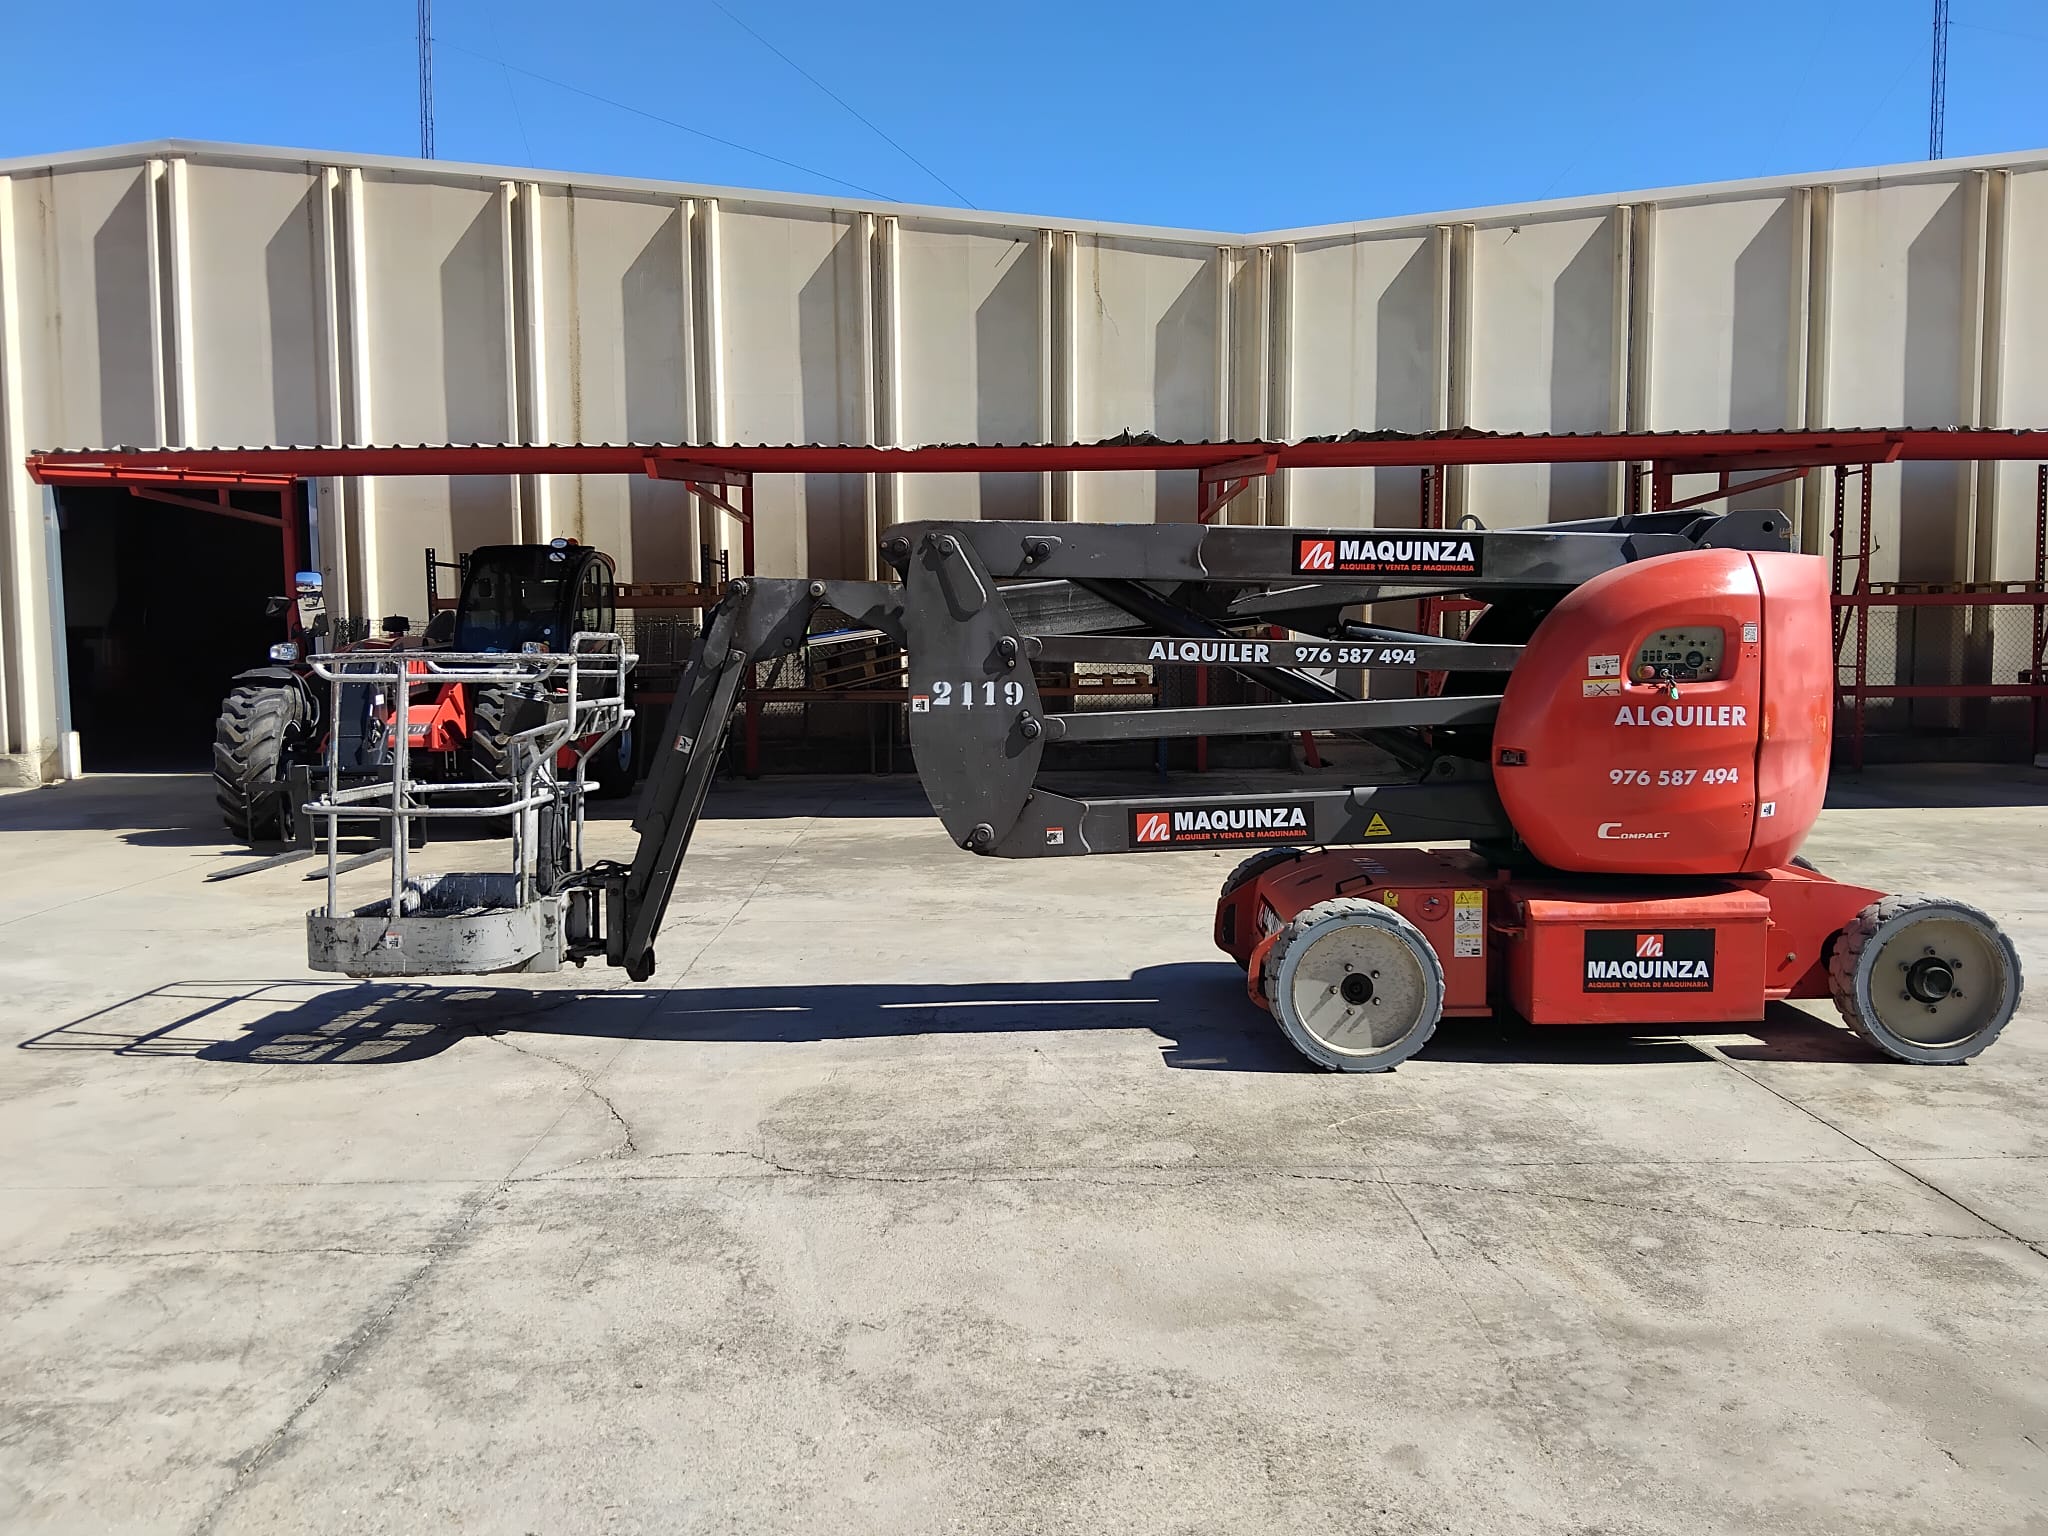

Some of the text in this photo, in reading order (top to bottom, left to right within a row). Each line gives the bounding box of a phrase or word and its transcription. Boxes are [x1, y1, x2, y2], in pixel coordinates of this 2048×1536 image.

[1339, 540, 1475, 562] MAQUINZA
[1339, 563, 1376, 571] ALQUILER
[1148, 641, 1416, 665] ALQUILER 976 587 494
[932, 681, 1024, 707] 2119
[1614, 705, 1747, 727] ALQUILER
[1609, 768, 1739, 786] 976 587 494
[1174, 807, 1307, 831] MAQUINZA
[1175, 829, 1307, 841] ALQUILER Y VENTA DE MAQUINARIA
[1587, 960, 1709, 979] MAQUINZA
